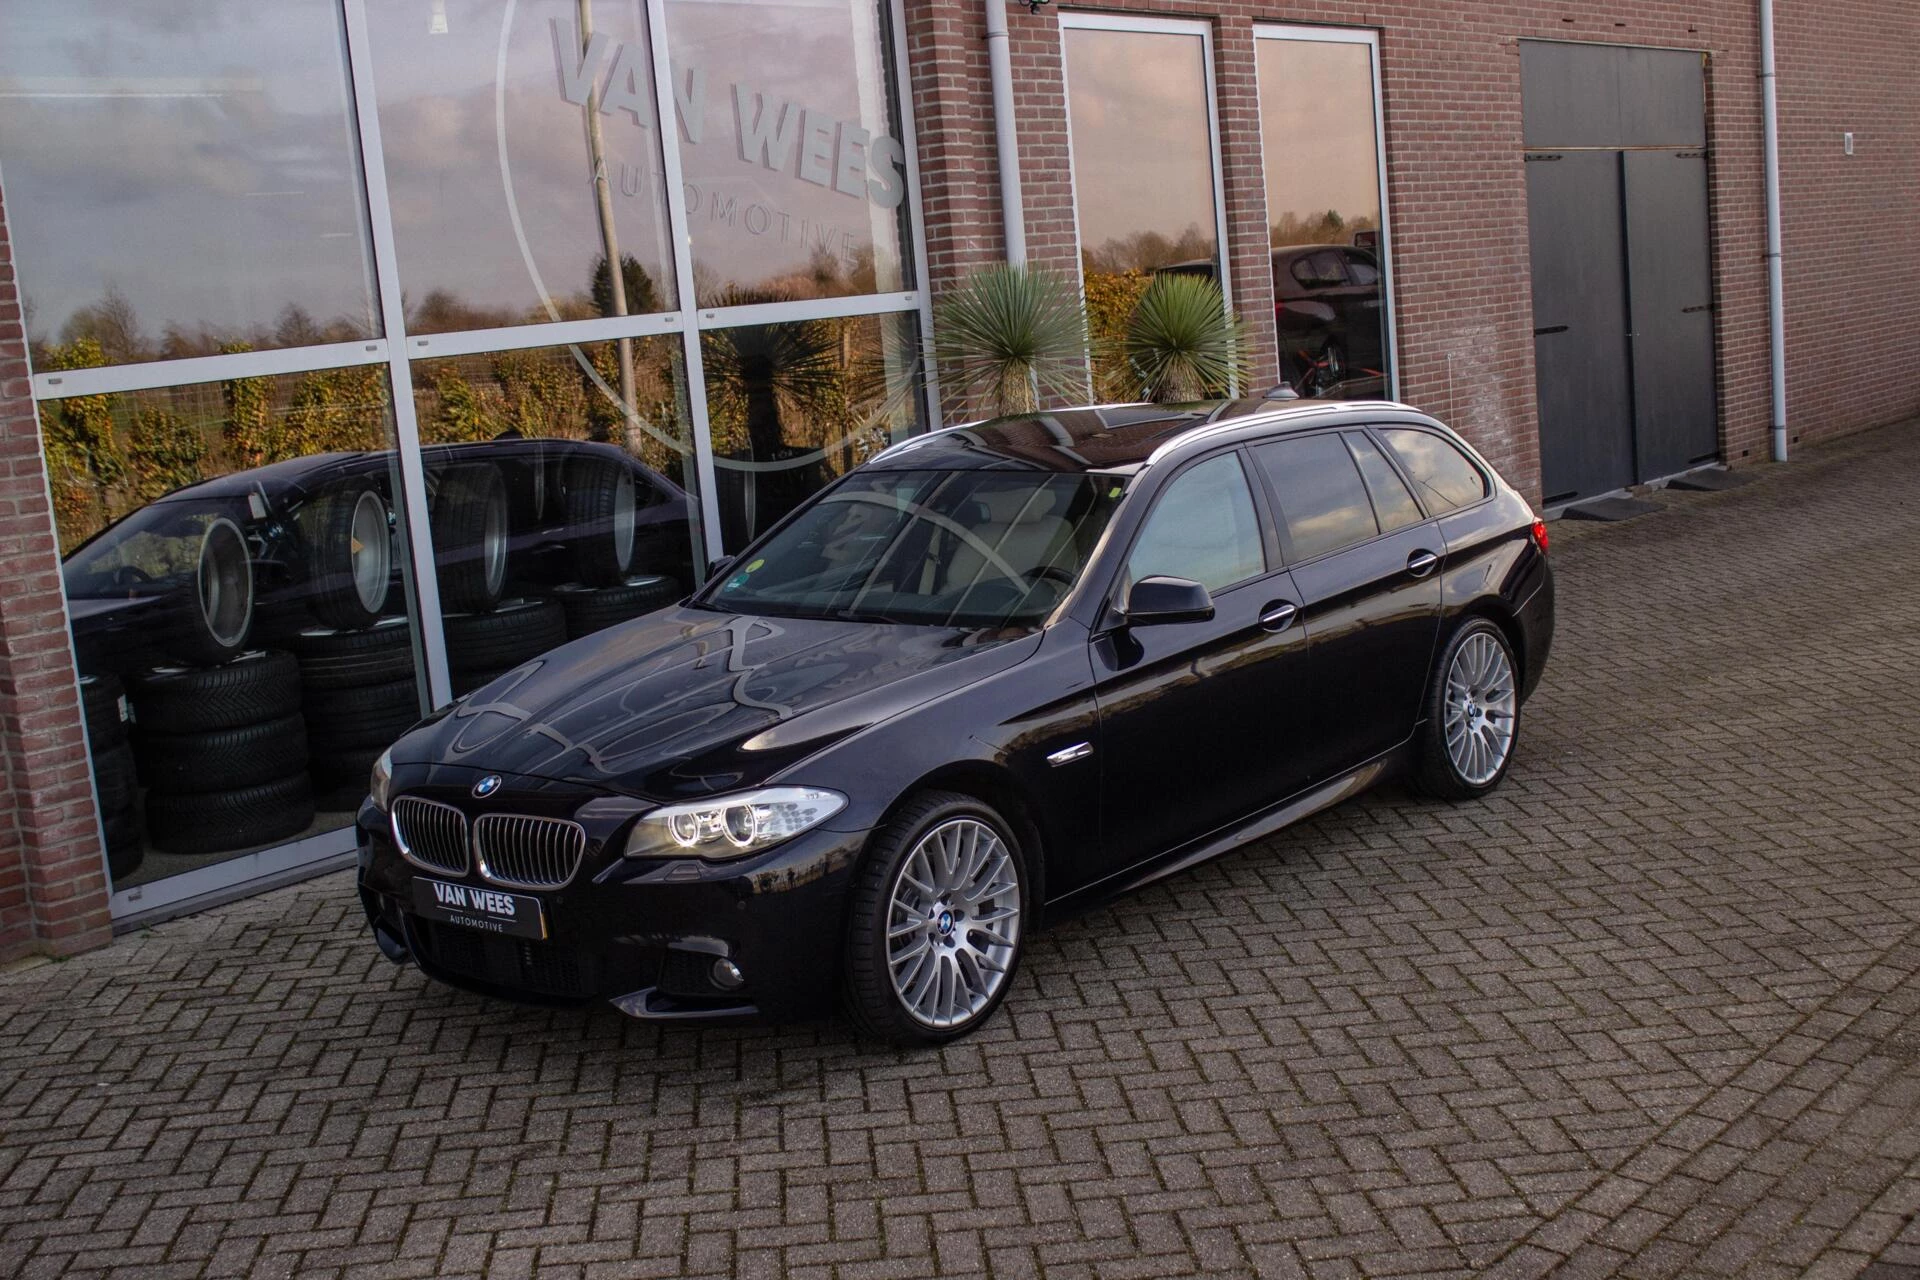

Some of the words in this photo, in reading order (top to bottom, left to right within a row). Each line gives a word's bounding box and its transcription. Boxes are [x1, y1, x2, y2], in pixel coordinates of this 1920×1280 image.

[550, 17, 708, 144] VAN
[731, 83, 905, 208] WEES
[433, 882, 467, 907] VAN
[469, 889, 516, 916] WEES
[450, 914, 503, 933] AUTOMOTIVE
